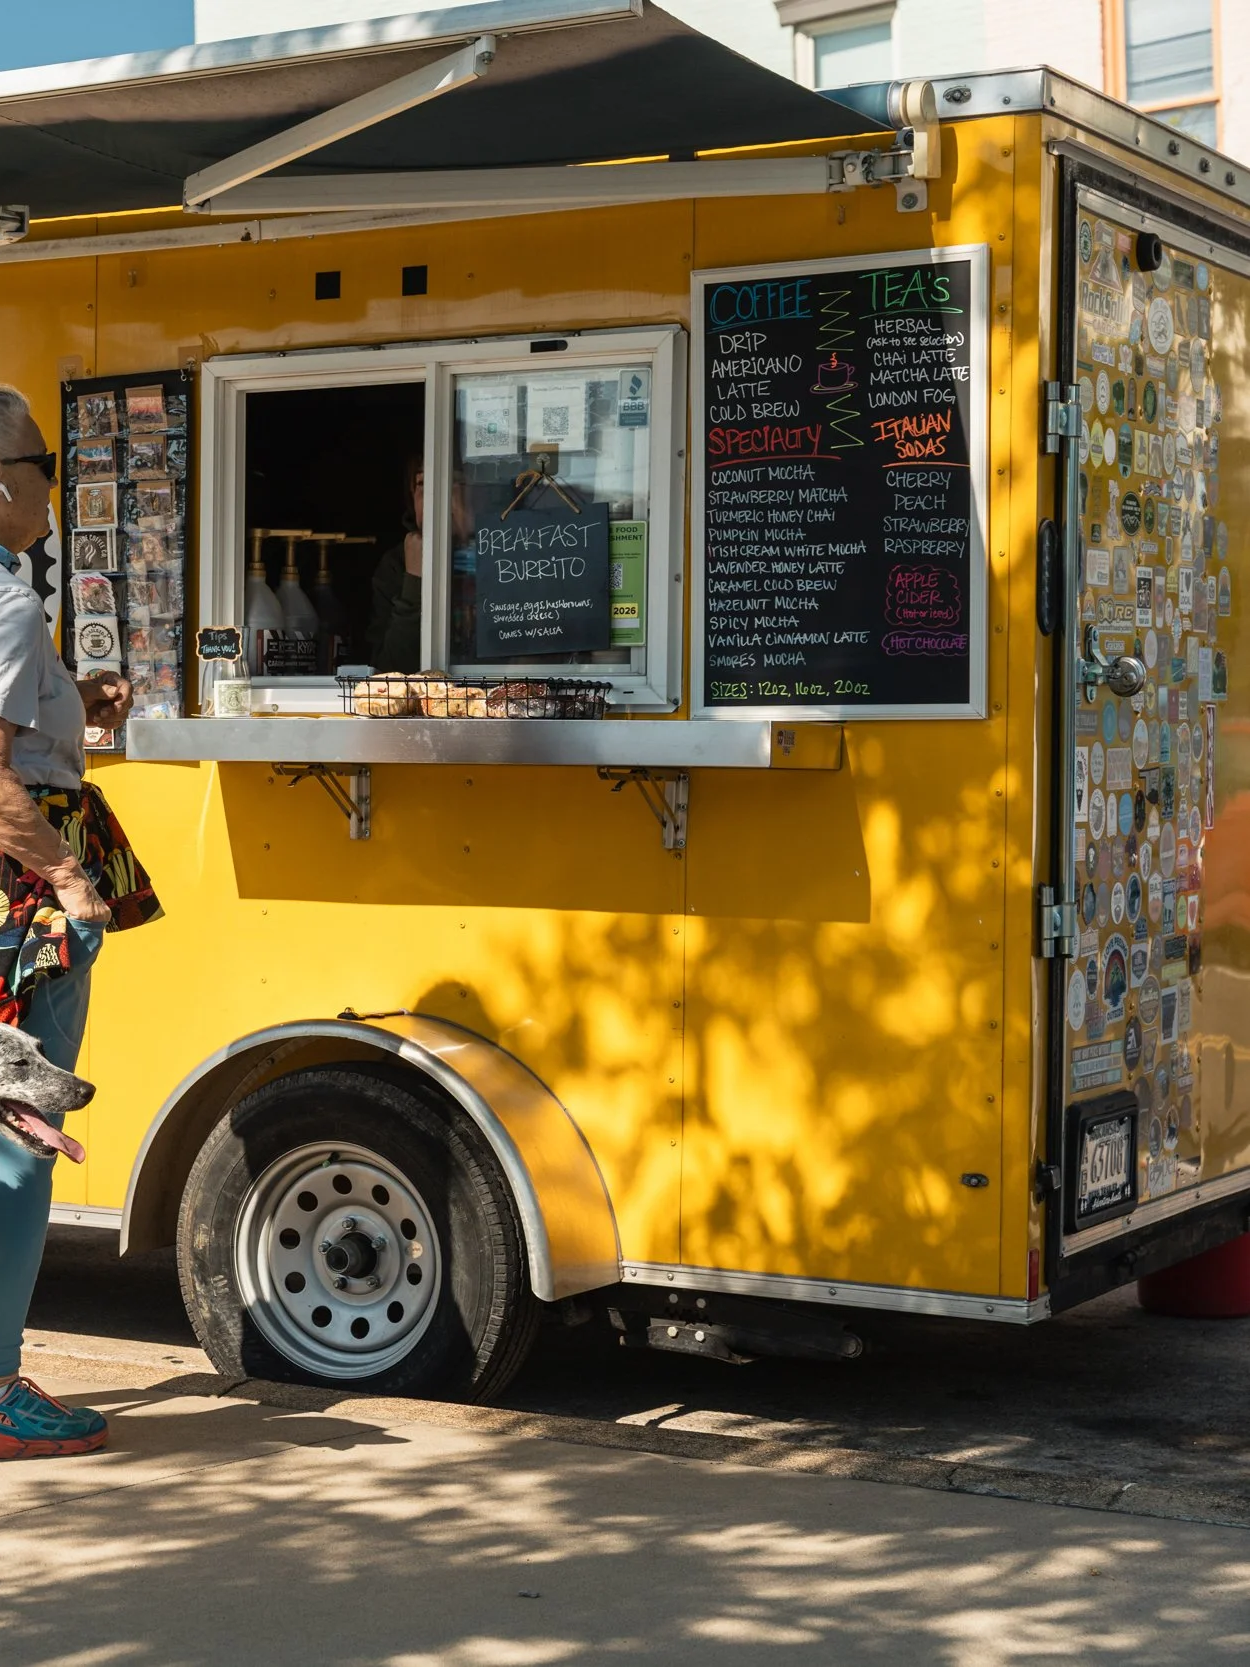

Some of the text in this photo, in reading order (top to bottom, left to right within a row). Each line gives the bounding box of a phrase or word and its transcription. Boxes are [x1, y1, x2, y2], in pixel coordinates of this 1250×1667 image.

[860, 270, 951, 310] TEA'S
[709, 279, 812, 325] COFFEE
[874, 318, 941, 334] HERBAL
[912, 348, 956, 363] LATTE
[870, 366, 970, 385] MATCHA LATTE
[716, 381, 771, 400] LATTE
[868, 388, 956, 408] LONDON FOG
[623, 402, 645, 411] BBB
[709, 400, 800, 423] COLD BREW
[895, 436, 946, 459] SODAS
[711, 464, 816, 486] COCONUT MOCHA
[886, 470, 951, 489] CHERRY
[707, 486, 848, 506] STRAWBERRY MATCHA
[894, 493, 946, 511] PEACH
[707, 509, 764, 524] TURMERIC
[768, 509, 804, 523] HONEY
[764, 527, 807, 541] MOCHA
[883, 516, 970, 537] STRAWBERRY
[477, 522, 601, 556] BREAKFAST
[740, 546, 780, 558] CREAM
[828, 540, 867, 555] MOCHA
[884, 538, 965, 558] RASPBERRY
[708, 561, 846, 575] LAVENDER HONEY LATTE
[708, 579, 837, 594] CARAMEL COLD BREW
[895, 573, 940, 588] APPLE
[613, 607, 636, 615] 2026
[708, 596, 819, 613] HAZELNUT MOCHA
[754, 615, 800, 628] MOCHA
[208, 631, 228, 643] Tips
[833, 631, 870, 644] LATTE
[890, 634, 968, 649] HOT CHOCOLATE
[709, 651, 807, 668] SMORES MOCHA
